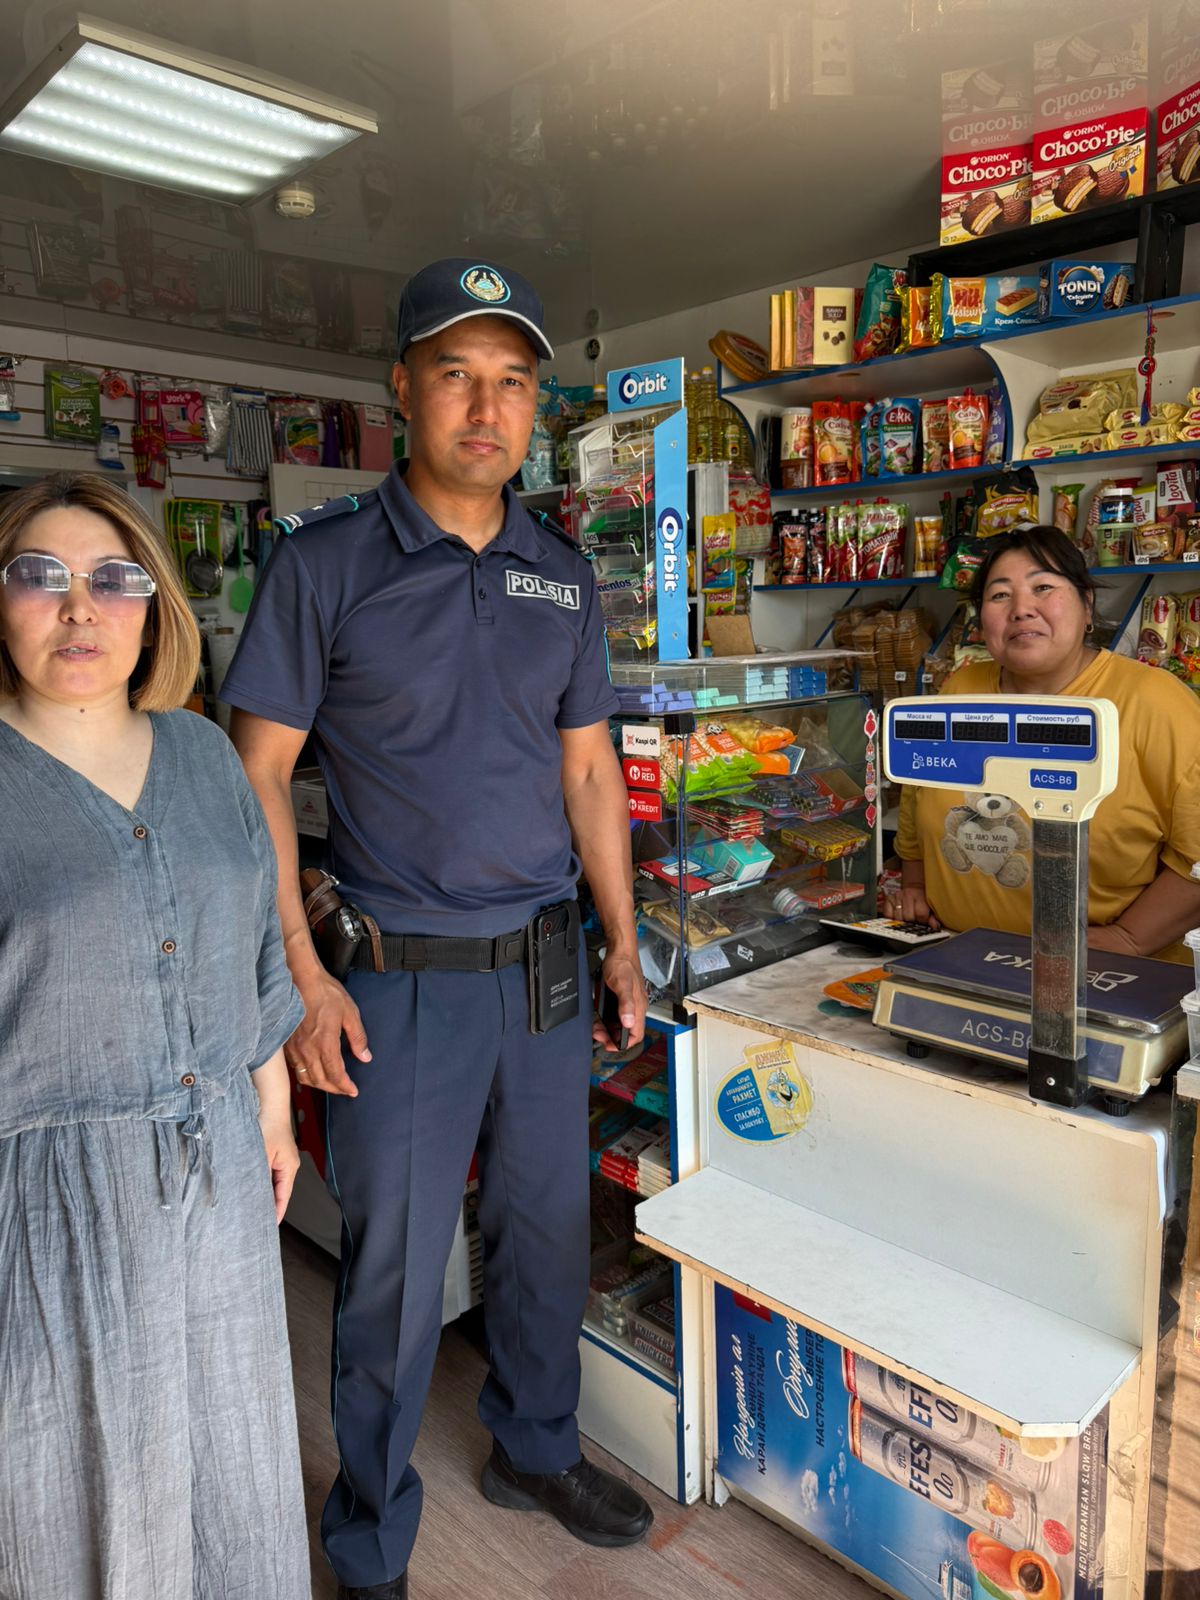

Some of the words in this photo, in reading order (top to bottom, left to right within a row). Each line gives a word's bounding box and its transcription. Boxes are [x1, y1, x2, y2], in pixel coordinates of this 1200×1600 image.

[1162, 101, 1200, 134] Choc
[1071, 124, 1104, 137] ORION
[980, 153, 1009, 163] ORION
[1108, 146, 1141, 172] Original
[1058, 279, 1100, 295] TONDI
[623, 373, 667, 399] Orbit
[661, 515, 680, 593] Orbit
[635, 737, 648, 745] Kaspi
[641, 772, 656, 782] RED
[1033, 774, 1072, 785] ACS-B6
[637, 804, 659, 814] KREDIT
[975, 833, 989, 841] AMO
[732, 1088, 757, 1104] РАХМЕТ
[734, 1106, 761, 1122] СПАСИБО
[815, 1356, 825, 1447] НАСТРОЕНИЕ
[909, 1382, 932, 1430] EF
[909, 1437, 932, 1500] EFES
[1081, 1454, 1091, 1484] SLOW
[933, 1472, 953, 1500] 0.0
[1078, 1489, 1090, 1580] MEDITERRANEAN
